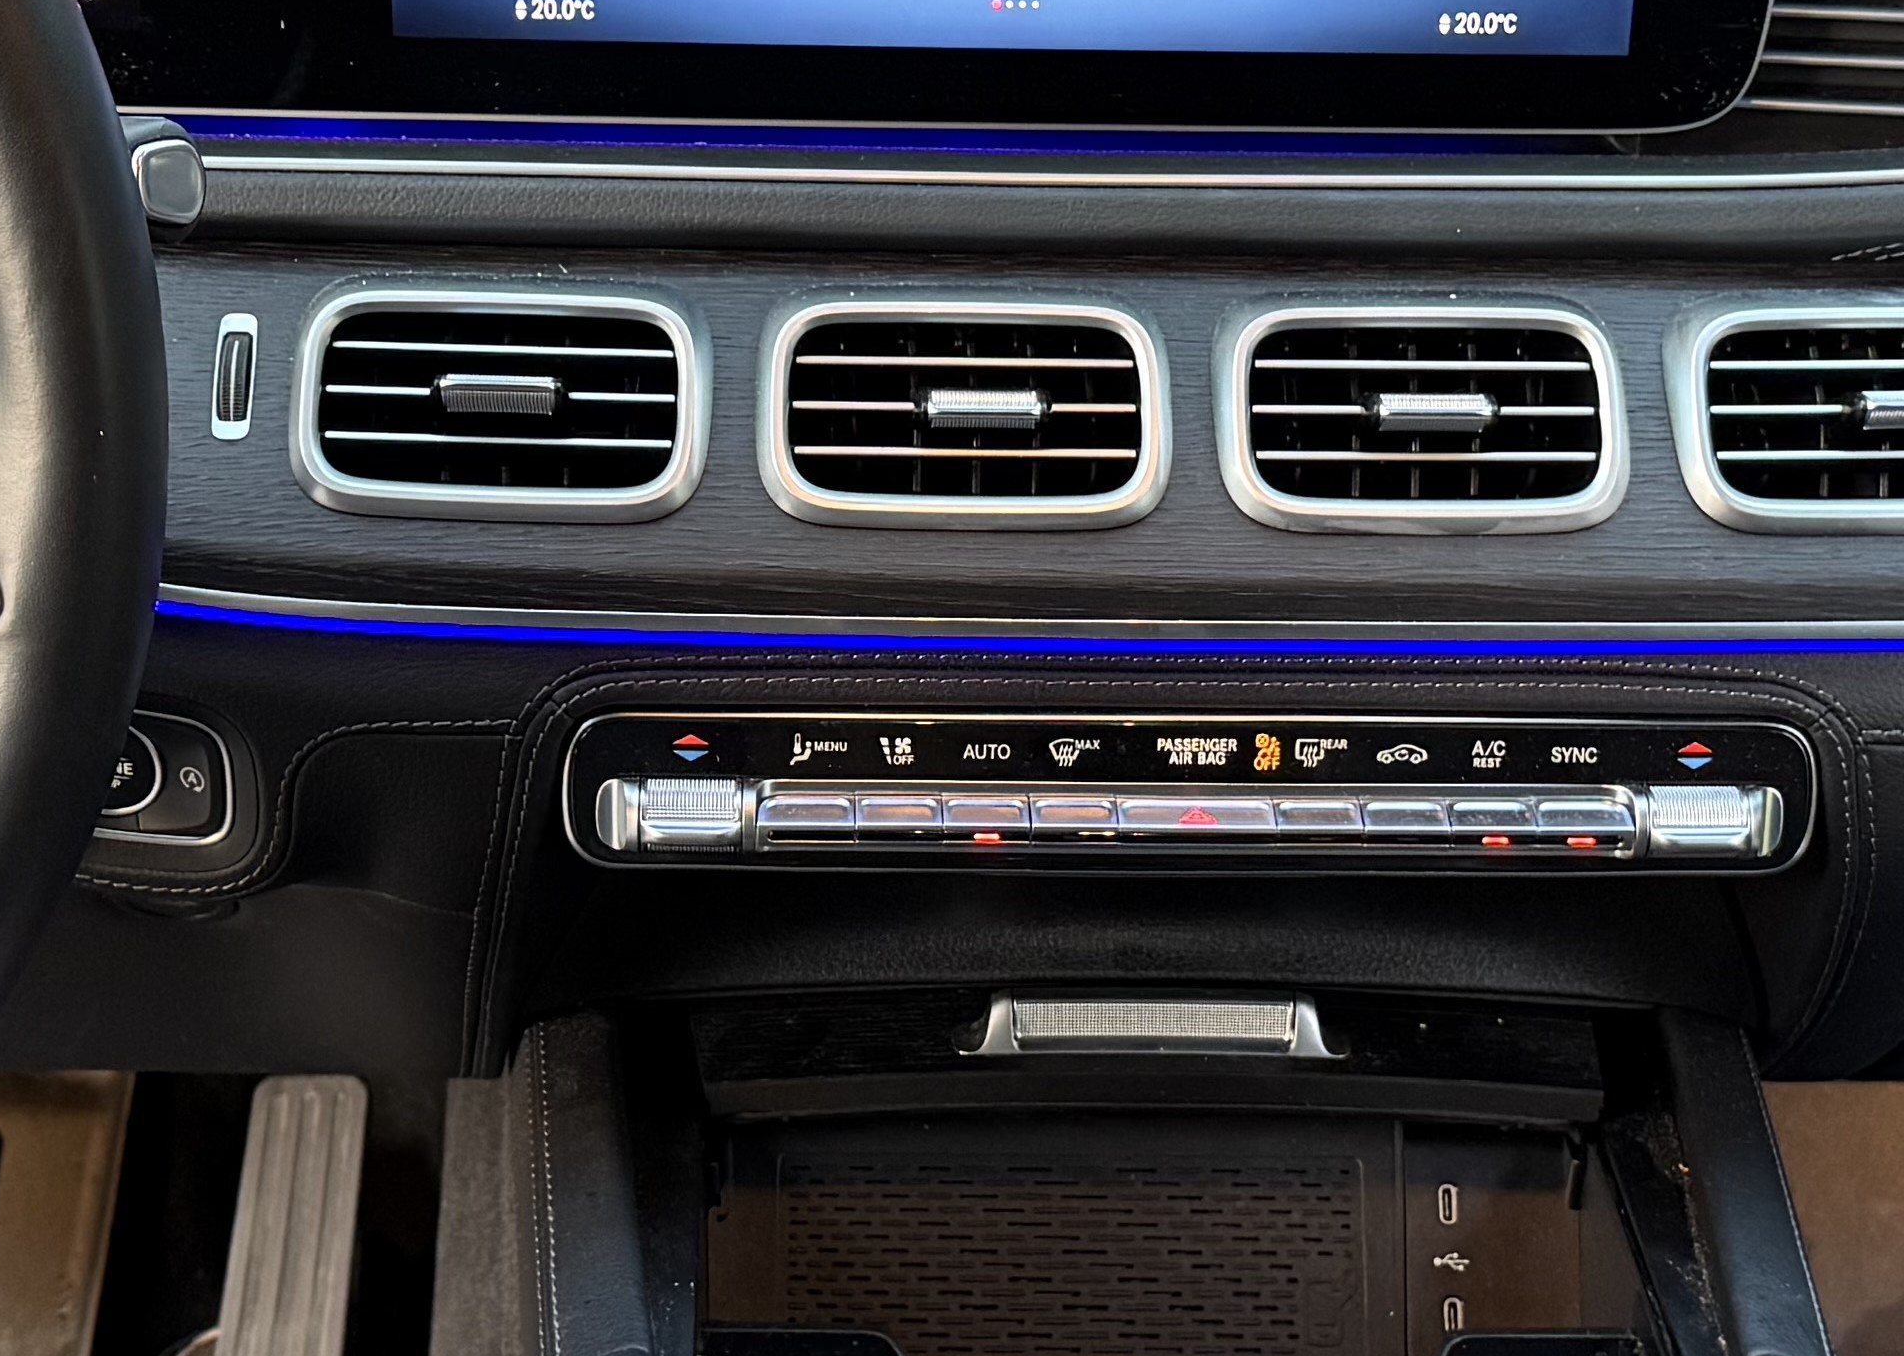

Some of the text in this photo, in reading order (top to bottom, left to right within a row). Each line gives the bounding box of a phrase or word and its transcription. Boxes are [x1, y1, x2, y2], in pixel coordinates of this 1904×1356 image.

[1453, 11, 1518, 35] 20.0°C
[814, 741, 848, 752] MENU
[962, 743, 1011, 760] AUTO
[1075, 739, 1101, 752] MAX
[1157, 738, 1238, 752] PASSENGER
[1318, 738, 1348, 752] REAR
[1471, 740, 1506, 757] A/C
[892, 752, 915, 766] OFF
[1168, 750, 1226, 766] AIR BAG
[1550, 746, 1598, 764] SYNC
[1253, 756, 1281, 771] OFF
[1472, 757, 1502, 768] REST
